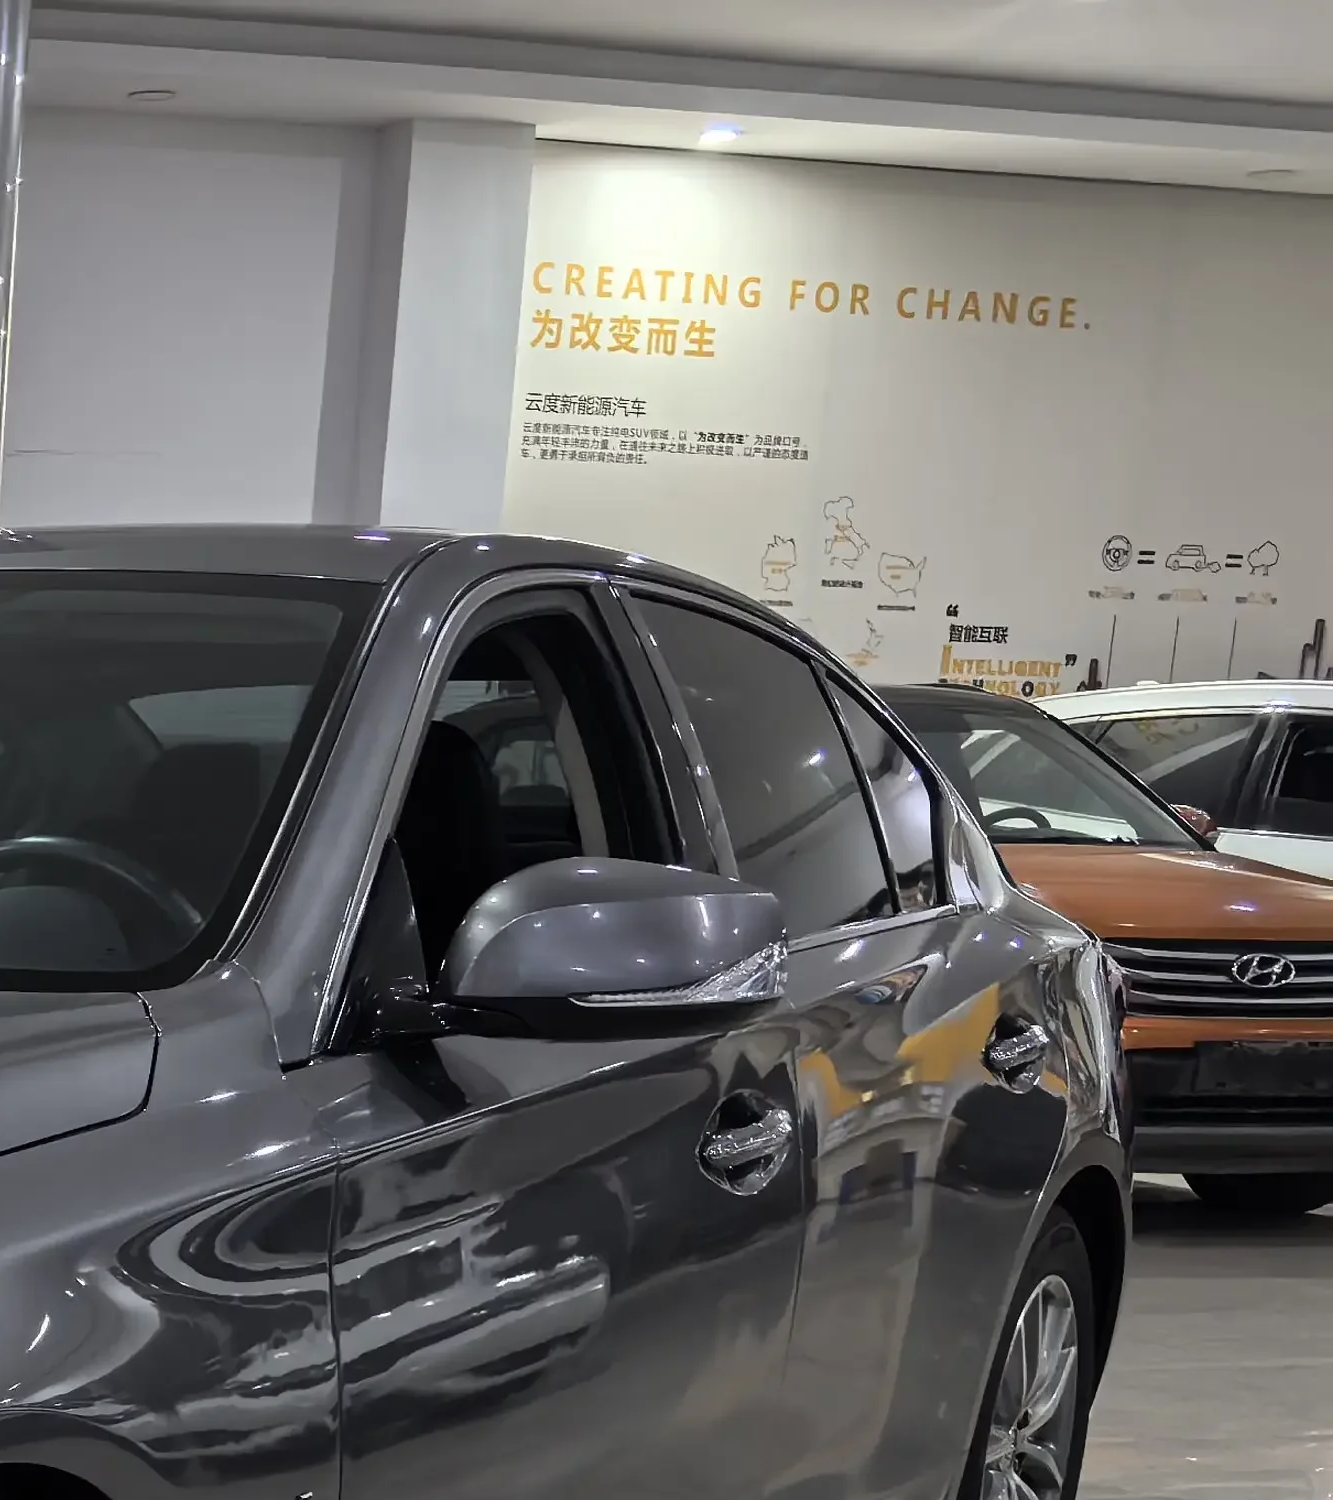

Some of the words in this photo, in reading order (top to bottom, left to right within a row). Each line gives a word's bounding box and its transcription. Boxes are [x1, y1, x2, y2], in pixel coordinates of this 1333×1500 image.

[532, 261, 762, 308] CREATING
[789, 279, 870, 316] FOR
[896, 286, 1091, 330] CHANGE.
[530, 308, 716, 358] 为改变而生
[524, 392, 647, 418] 云度新能源汽车
[948, 623, 1009, 644] 智能互联
